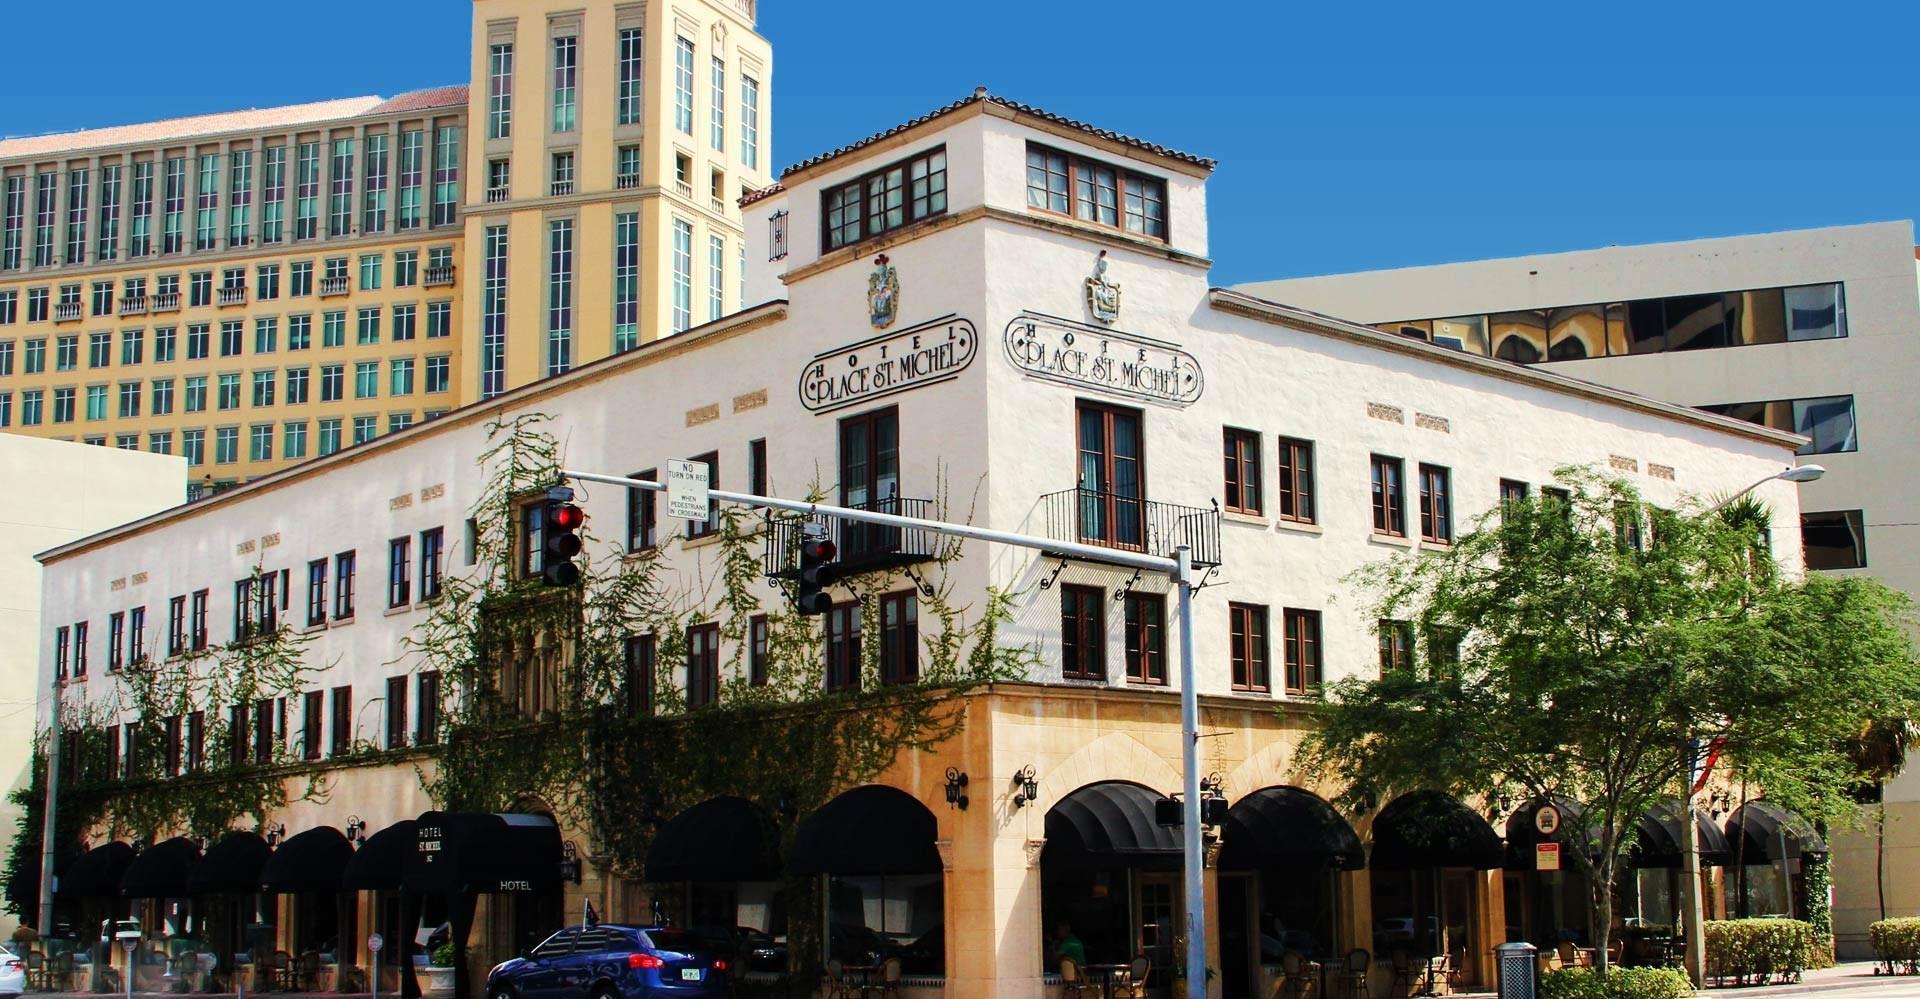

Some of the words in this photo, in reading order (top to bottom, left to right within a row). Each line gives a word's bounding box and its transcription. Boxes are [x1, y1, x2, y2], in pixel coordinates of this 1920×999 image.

[816, 327, 956, 377] HOTEL
[1026, 324, 1180, 369] HOTEL
[817, 367, 869, 403] PLACE
[873, 361, 897, 388] ST.
[900, 342, 960, 381] MICHEL
[1026, 341, 1088, 377] PLACE
[1093, 356, 1118, 382] ST.
[1122, 361, 1185, 396] MICHEL
[683, 463, 693, 473] NO
[669, 470, 684, 479] TURN
[685, 472, 694, 480] ON
[695, 473, 707, 482] RED
[670, 501, 706, 511] PEDESTRIANS
[677, 509, 706, 518] CROSSWALK
[419, 827, 442, 838] HOTEL
[500, 881, 532, 891] HOTEL
